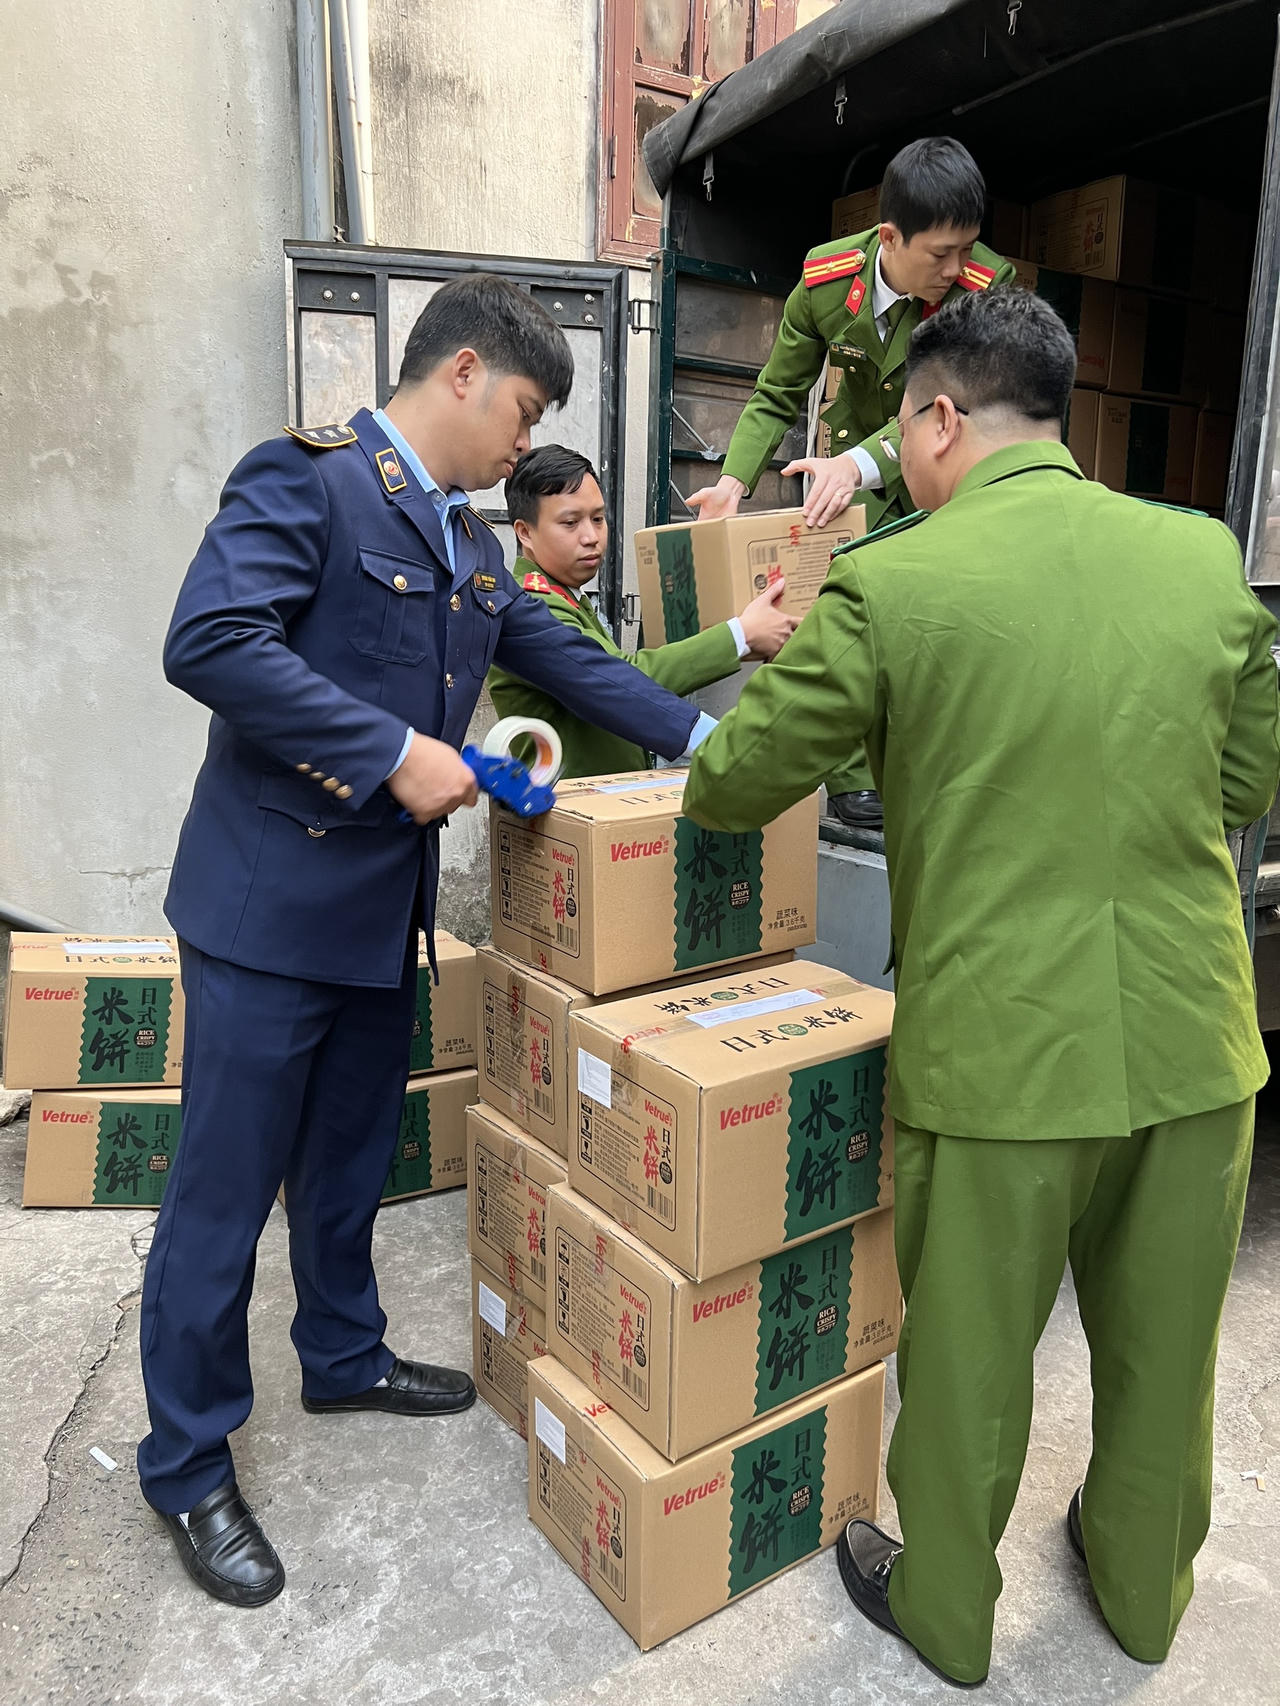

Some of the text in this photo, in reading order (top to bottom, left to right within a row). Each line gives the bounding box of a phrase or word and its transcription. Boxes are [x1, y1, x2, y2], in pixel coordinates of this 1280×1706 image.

[610, 839, 663, 862] Vetrue
[732, 881, 749, 891] RICE
[25, 987, 73, 1000] Vetrue
[136, 987, 157, 1026] 日式
[88, 986, 135, 1074] 米饼
[719, 1028, 791, 1053] 日式
[801, 1006, 864, 1030] 米饼
[42, 1110, 88, 1124] Vetrue
[719, 1098, 777, 1131] Vetrue
[848, 1065, 871, 1127] 日式
[151, 1113, 170, 1150] 日式
[661, 1127, 671, 1164] 日式
[795, 1078, 846, 1217] 米饼
[103, 1112, 148, 1197] 米饼
[643, 1125, 660, 1187] 米饼
[818, 1245, 839, 1305] 日式
[692, 1288, 748, 1324] Vetrue
[765, 1262, 815, 1391] 米饼
[819, 1306, 836, 1319] RICE
[619, 1309, 635, 1368] 米饼
[635, 1314, 645, 1348] 日式
[791, 1429, 812, 1487] 日式
[664, 1477, 719, 1516] Vetrue
[739, 1450, 788, 1574] 米饼
[596, 1500, 611, 1556] 米饼
